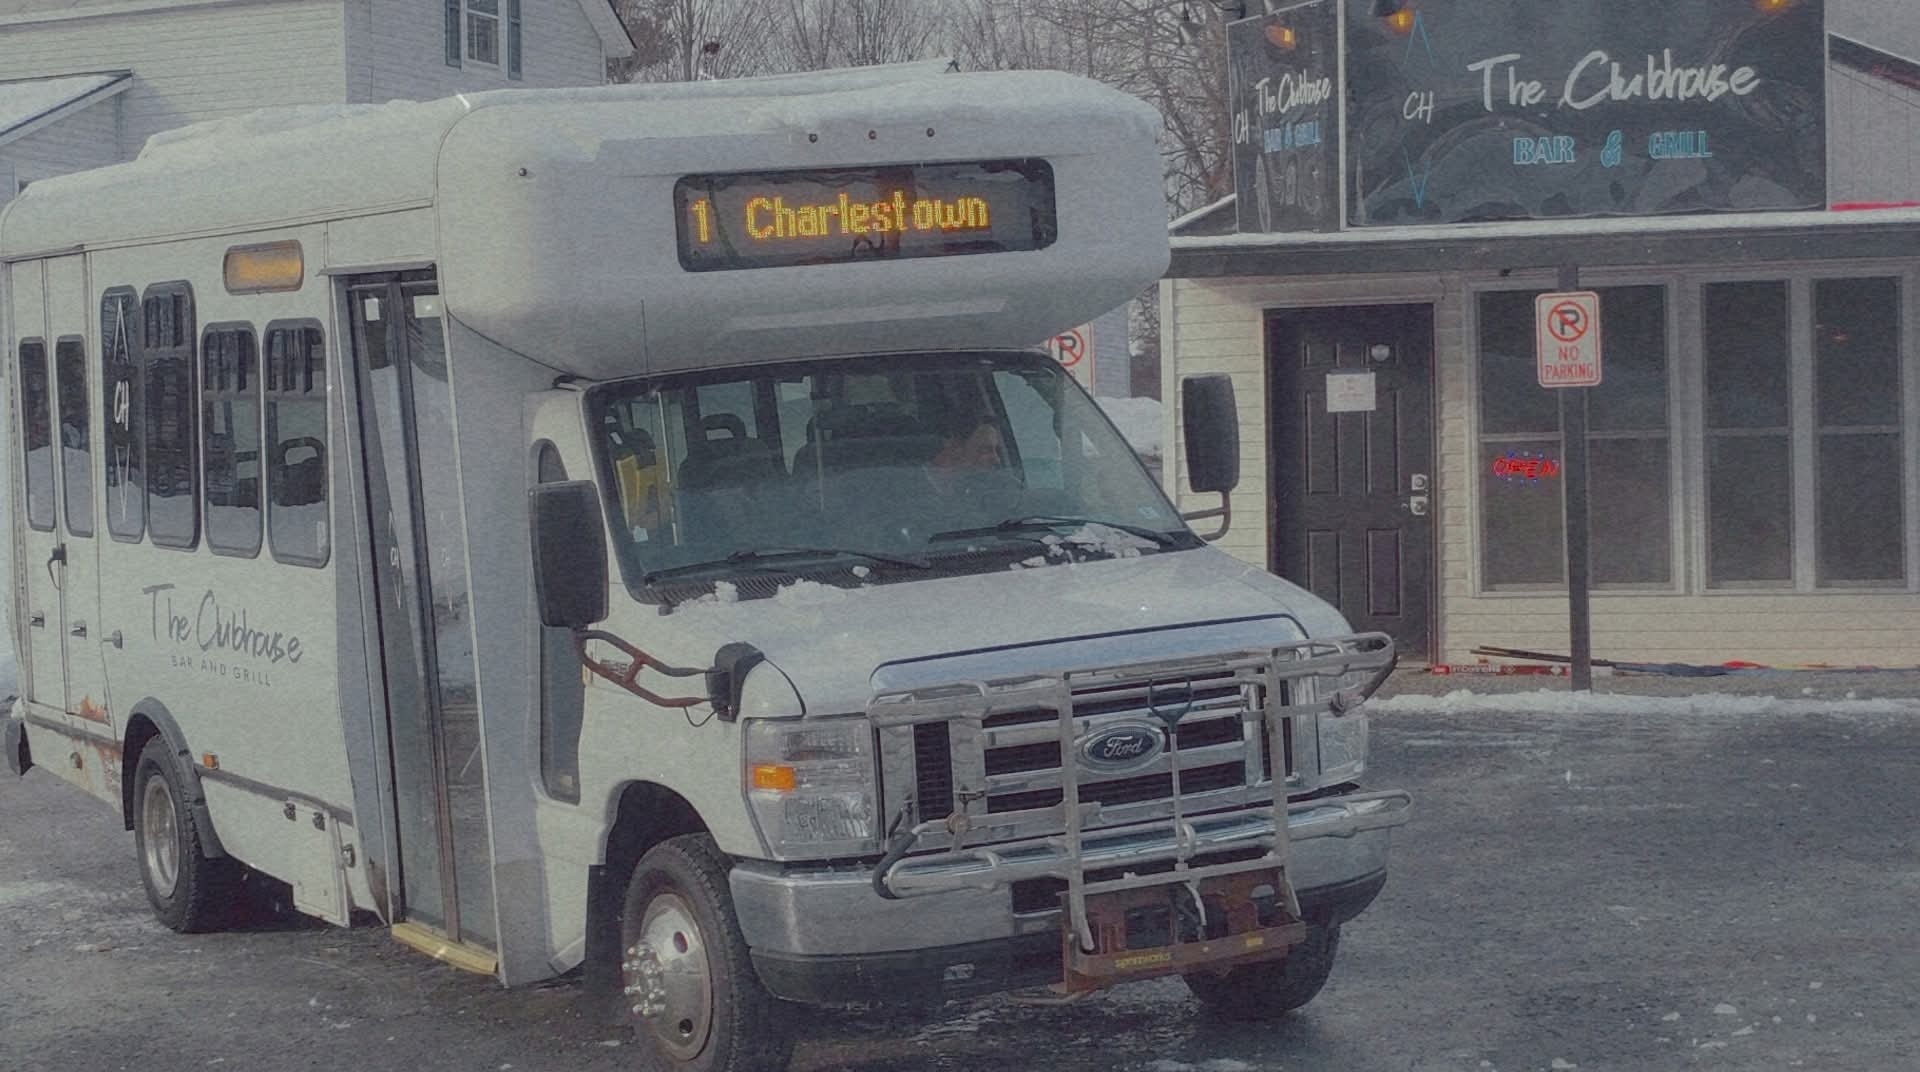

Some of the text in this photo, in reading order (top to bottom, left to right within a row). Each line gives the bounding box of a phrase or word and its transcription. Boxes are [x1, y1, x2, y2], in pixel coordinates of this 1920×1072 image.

[1255, 77, 1277, 117] The
[1466, 48, 1761, 112] The Clubhouse
[1402, 90, 1434, 124] CH
[1234, 109, 1249, 145] CH
[1512, 129, 1713, 168] BAR & GRILL
[692, 190, 991, 243] 1 Charlestown
[1545, 363, 1595, 380] PARKING
[1558, 345, 1580, 361] NO
[113, 379, 130, 432] CH
[142, 583, 304, 665] The Clubhouse
[171, 654, 272, 688] BAR AND GRILL
[1103, 735, 1143, 759] Ford
